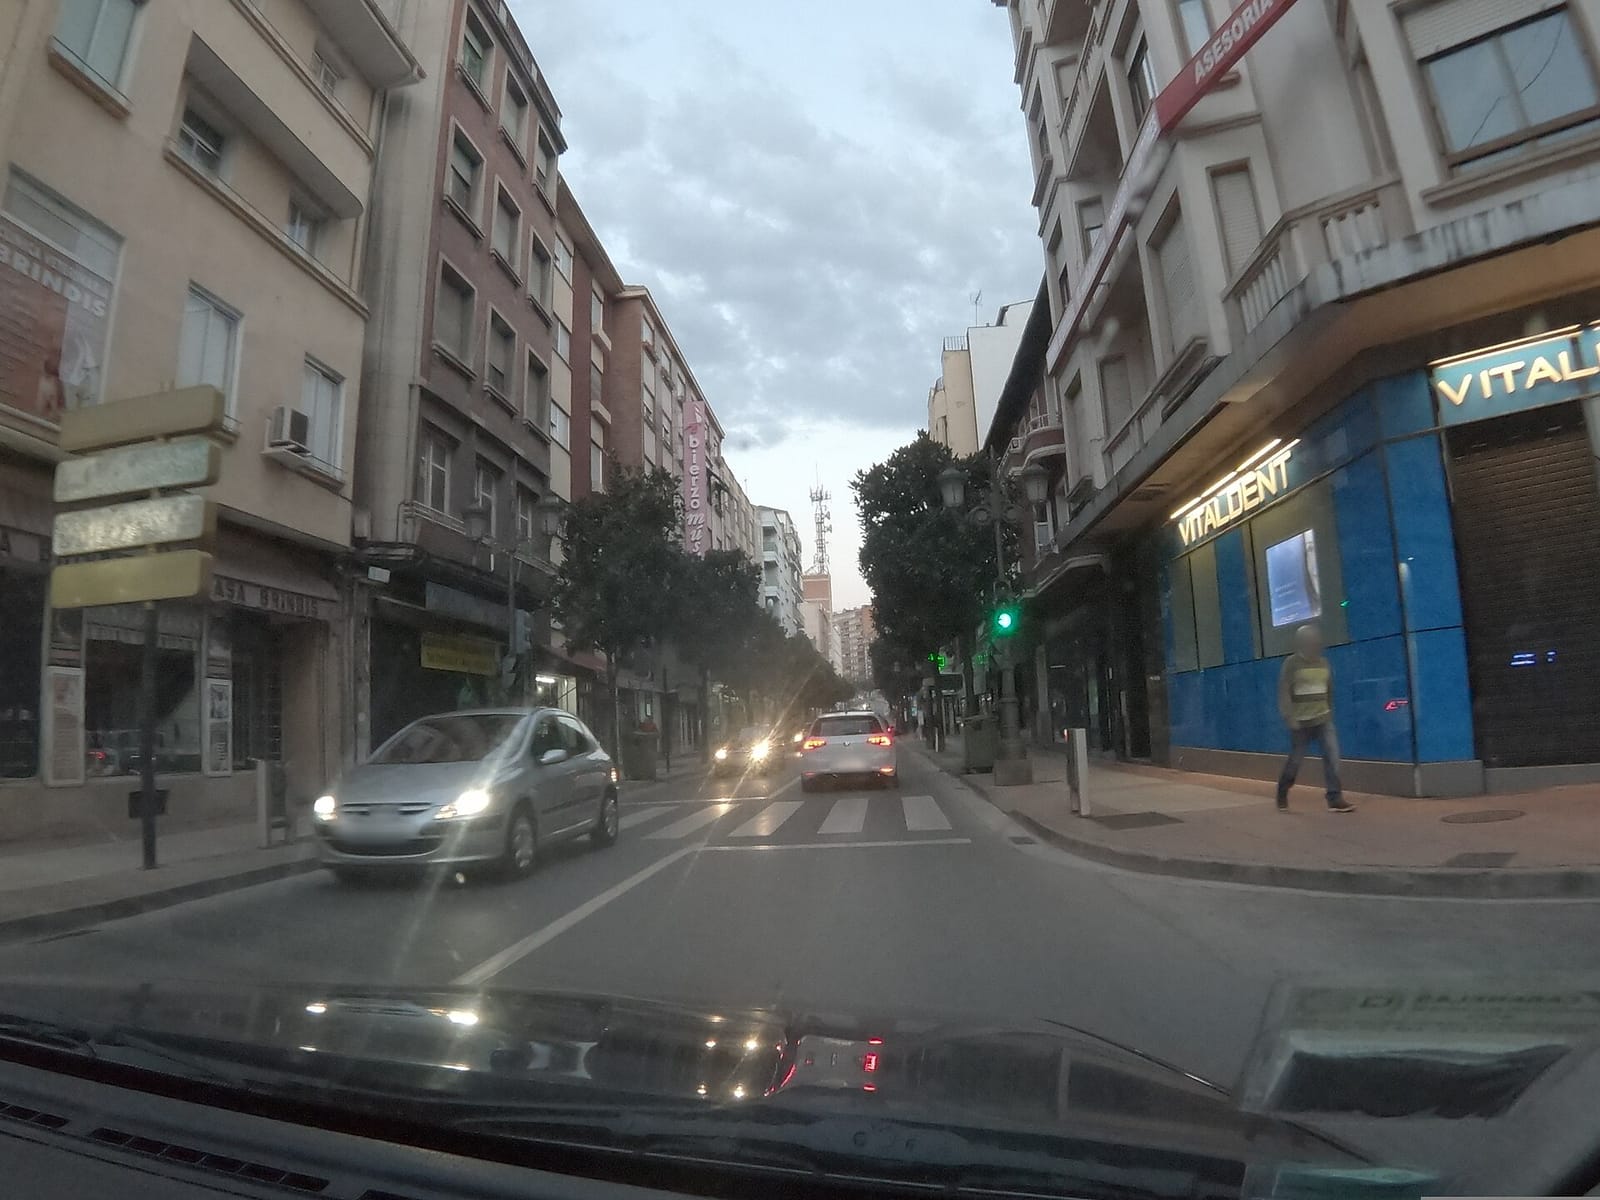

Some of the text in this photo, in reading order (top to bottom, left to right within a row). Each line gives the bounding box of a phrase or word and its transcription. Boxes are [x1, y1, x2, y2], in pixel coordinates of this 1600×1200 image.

[1195, 0, 1273, 85] ASESORIA
[1438, 342, 1600, 406] VITAL
[687, 433, 705, 558] bierzo mús
[1178, 450, 1293, 546] VITALDENT
